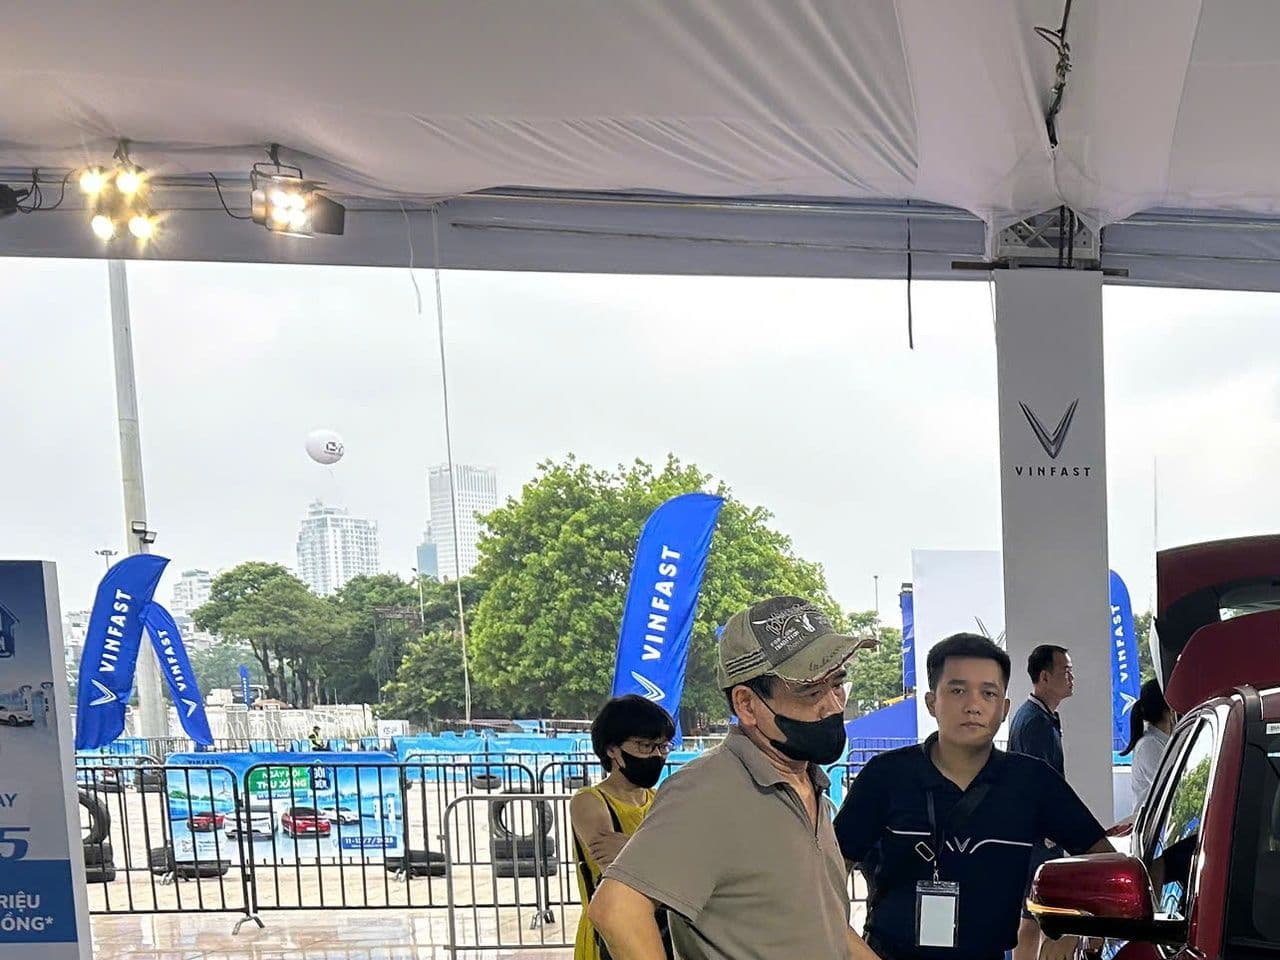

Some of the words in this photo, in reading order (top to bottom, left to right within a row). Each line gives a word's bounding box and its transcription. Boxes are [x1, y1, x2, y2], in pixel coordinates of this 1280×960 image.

[1015, 466, 1091, 477] VINFAST
[98, 589, 132, 672] VINFAST
[641, 545, 681, 661] VINFAST
[157, 630, 187, 692] VINFAST
[1110, 604, 1129, 683] VINFAST
